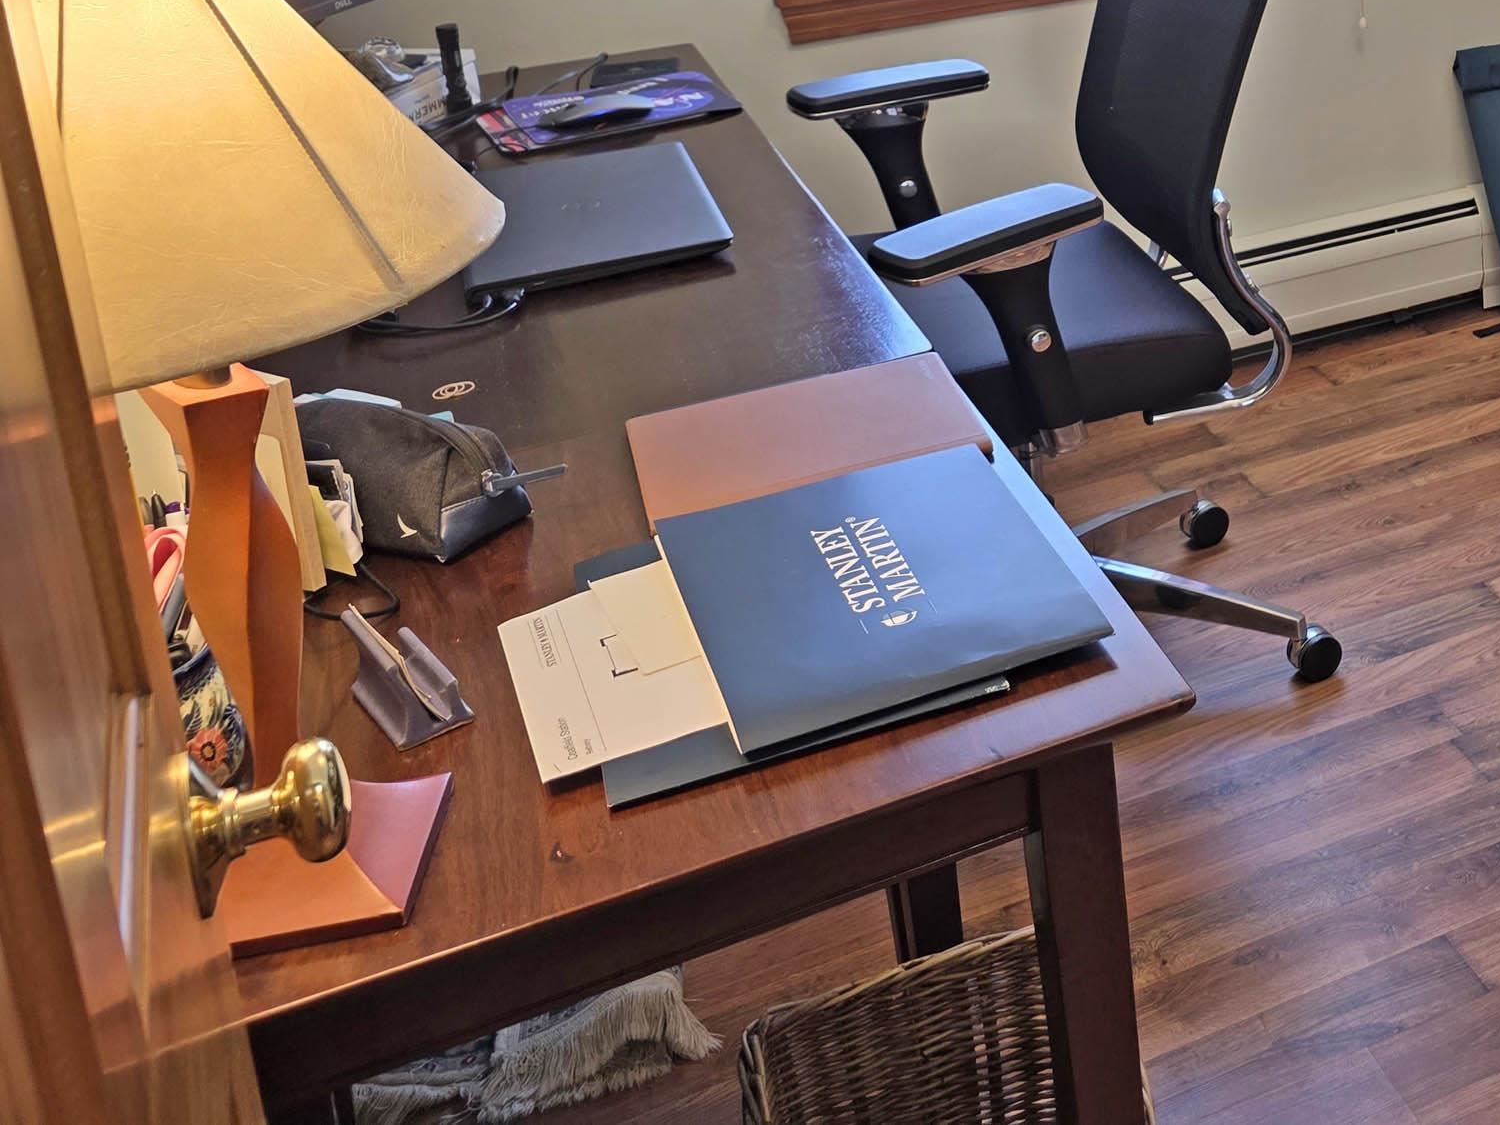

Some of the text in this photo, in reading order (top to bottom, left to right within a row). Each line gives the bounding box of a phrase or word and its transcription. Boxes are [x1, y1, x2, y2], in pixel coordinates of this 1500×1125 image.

[810, 526, 887, 613] STANLEY
[850, 517, 926, 603] MARTIN
[532, 617, 558, 668] STANLEY MARTIN
